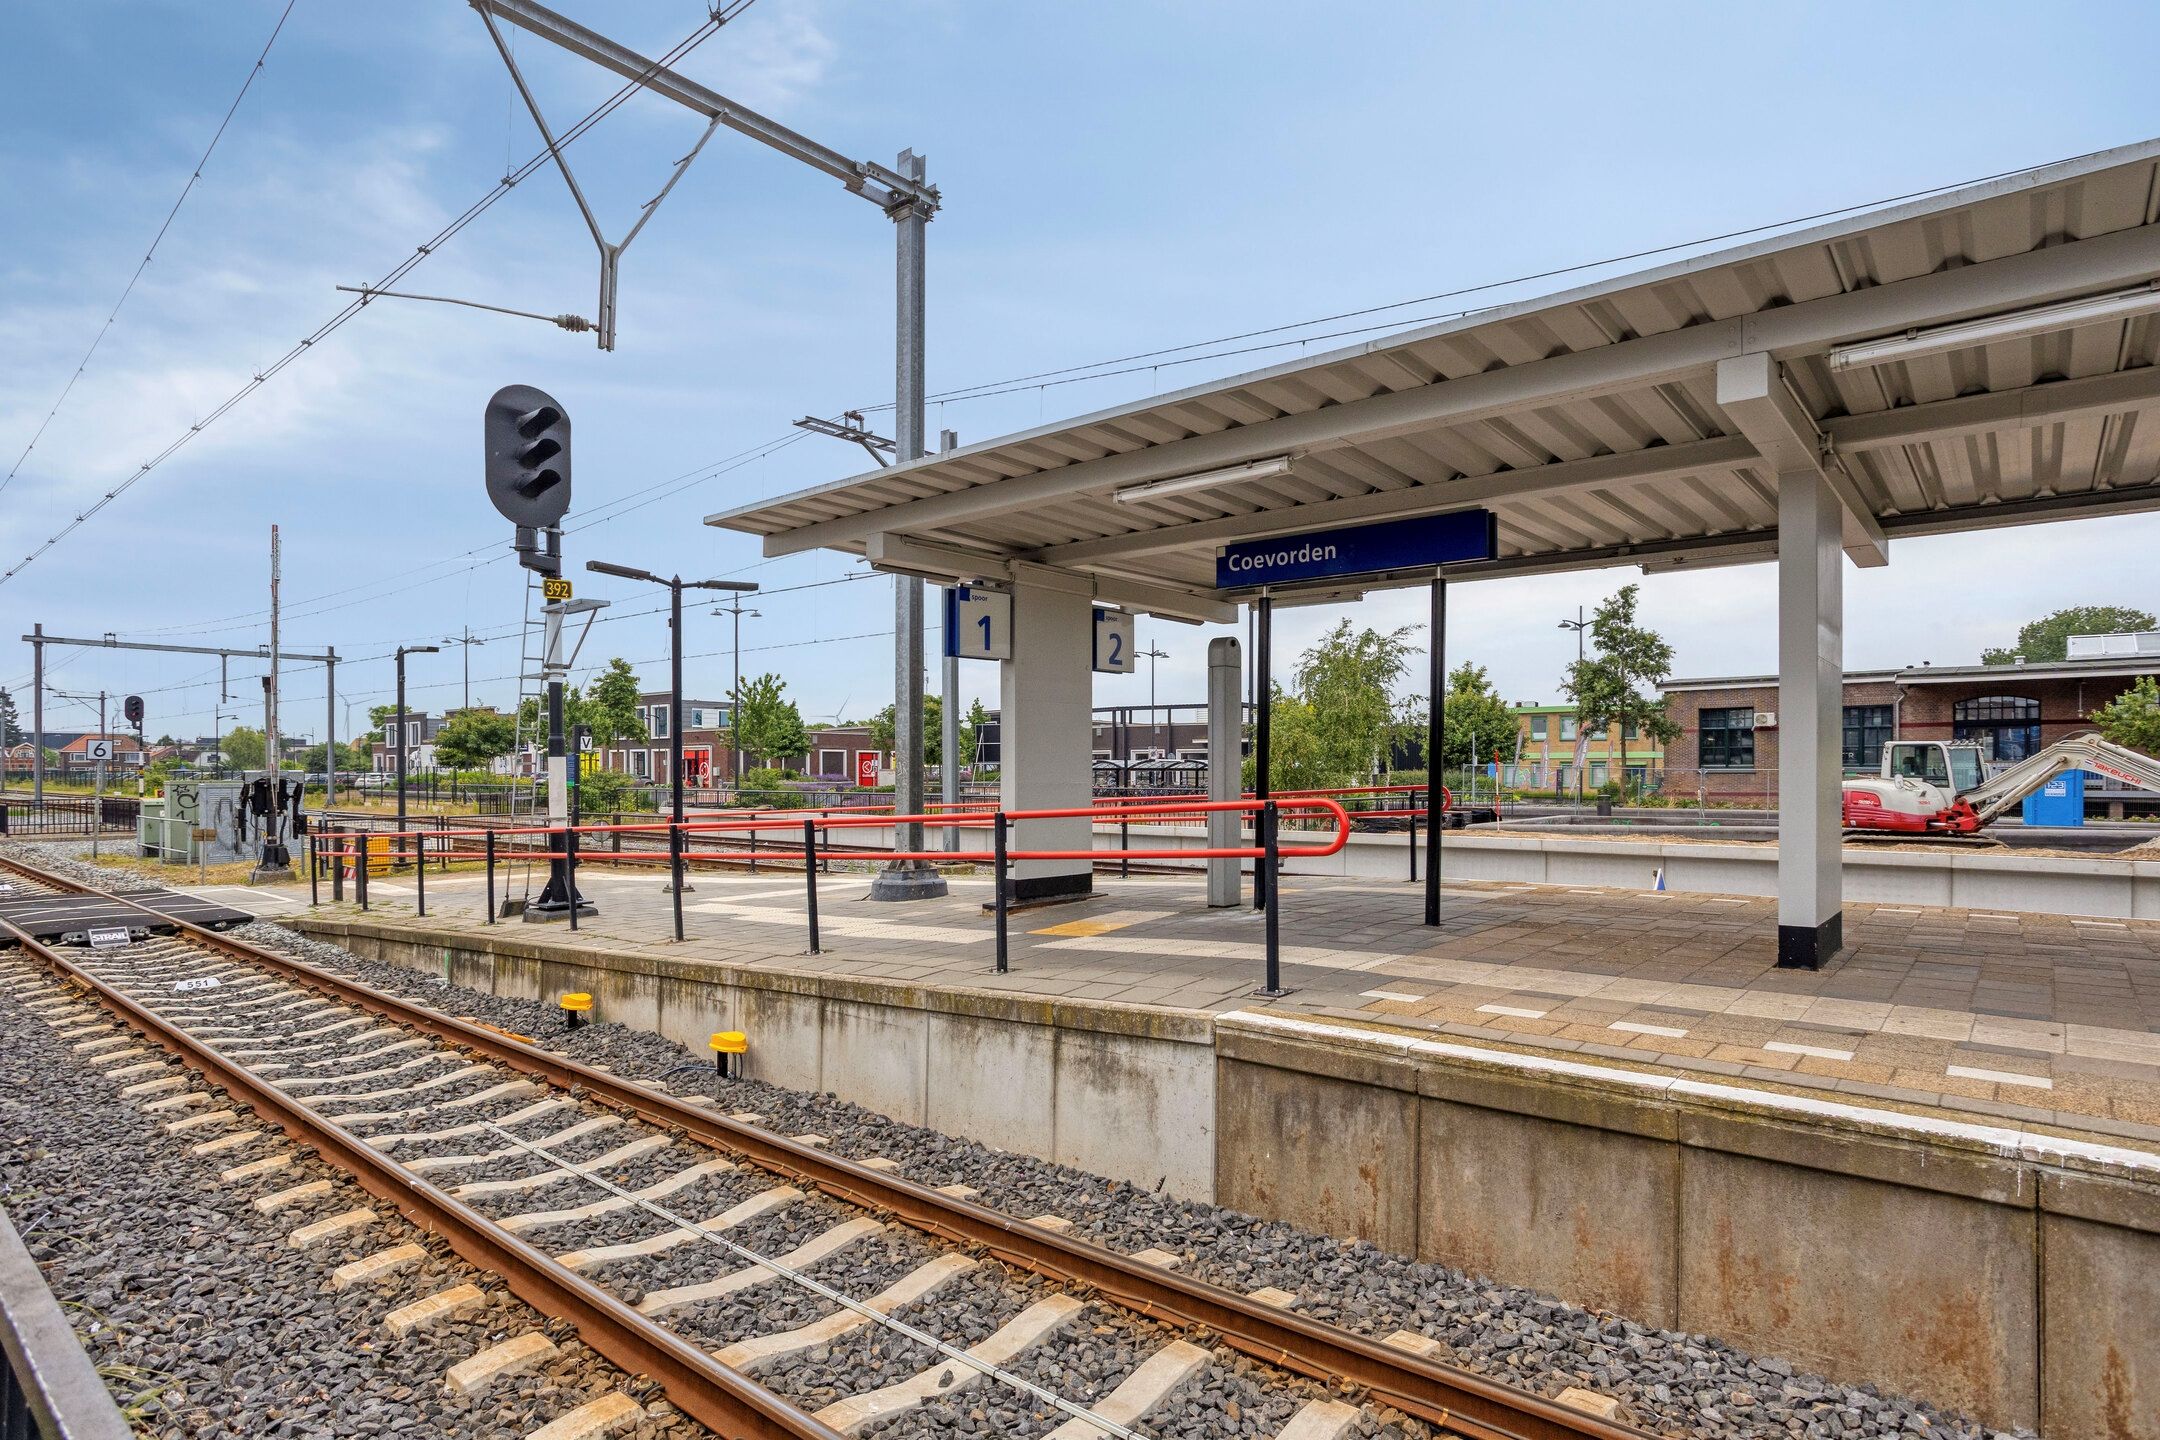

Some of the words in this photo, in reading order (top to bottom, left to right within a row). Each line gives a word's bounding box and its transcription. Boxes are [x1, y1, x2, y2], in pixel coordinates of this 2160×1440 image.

[1228, 543, 1337, 572] Coevorden
[546, 582, 569, 596] 392
[971, 594, 988, 602] spoor
[977, 615, 991, 651] 1
[1109, 633, 1123, 665] 2
[94, 742, 106, 757] 6
[582, 738, 592, 748] V
[2093, 761, 2143, 785] TAKEUCHI
[92, 931, 128, 941] STRAIL
[187, 980, 208, 988] 551
